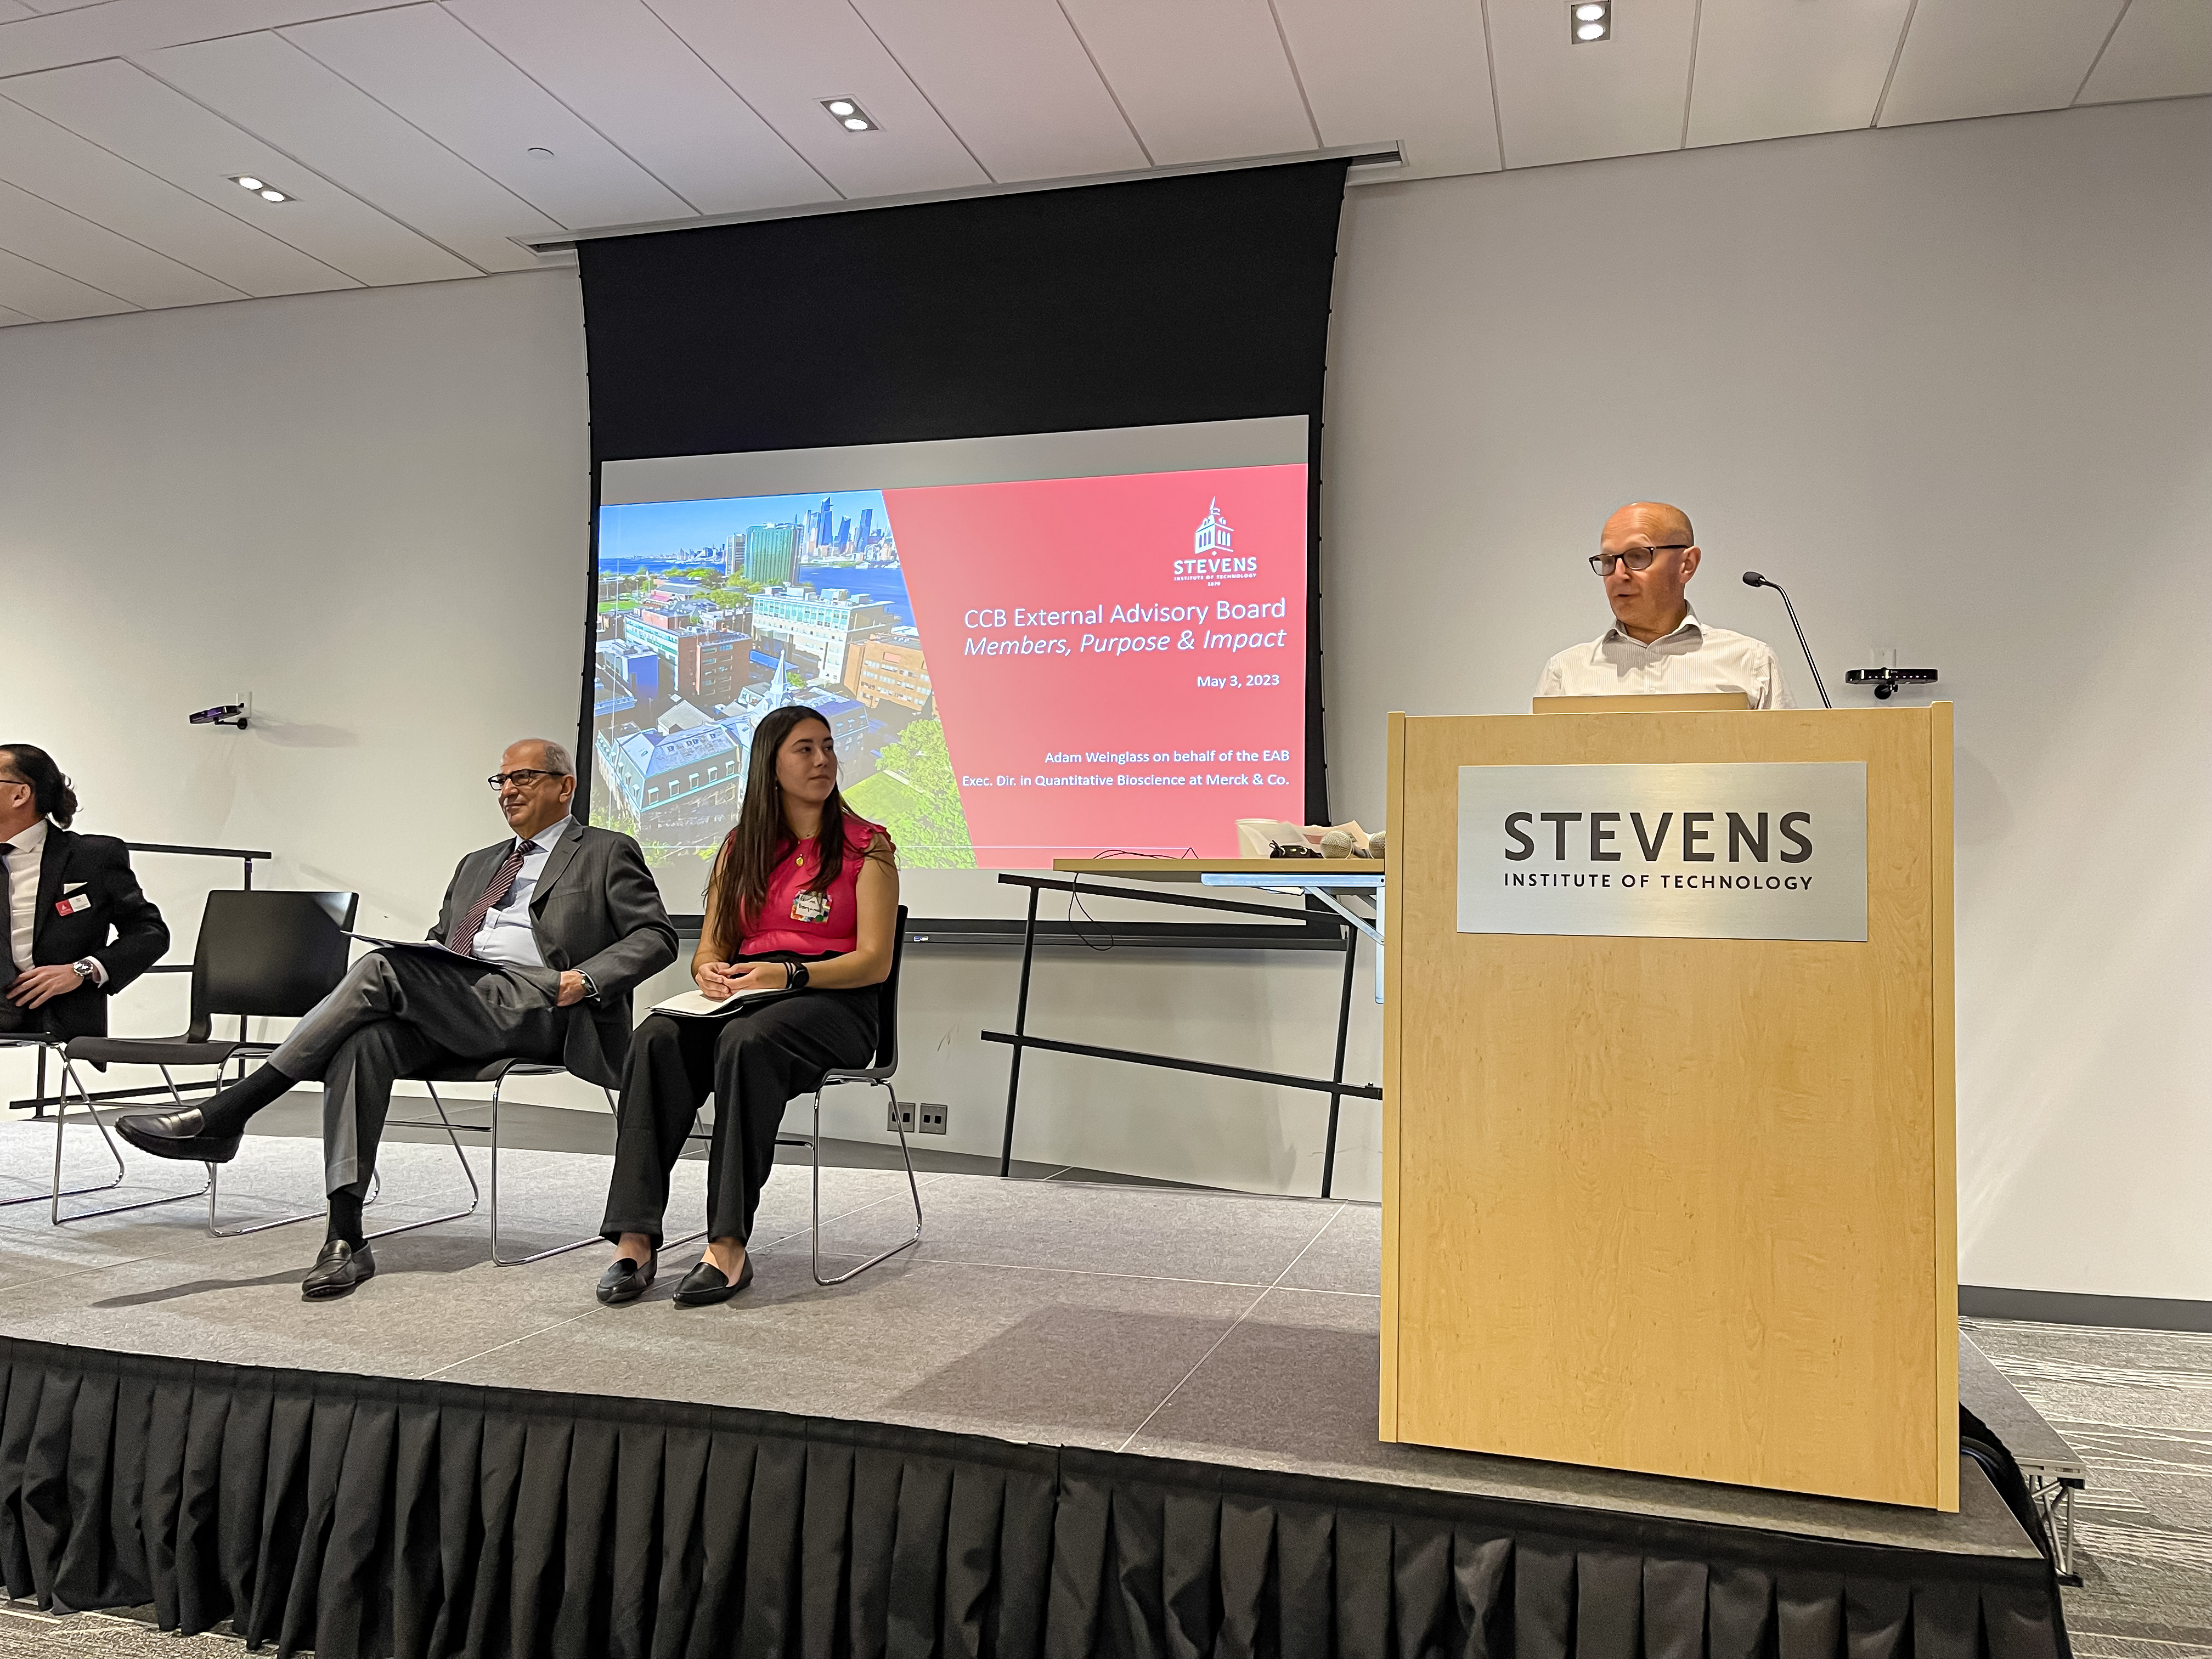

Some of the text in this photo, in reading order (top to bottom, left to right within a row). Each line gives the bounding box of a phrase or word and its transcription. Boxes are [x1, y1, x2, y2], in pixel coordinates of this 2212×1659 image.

[1174, 557, 1257, 574] STEVENS
[964, 597, 1285, 628] CCB External Advisory Board
[964, 629, 1287, 657] Members, Purpose & Impact
[1197, 674, 1280, 689] May 3, 2023
[1045, 750, 1290, 765] Adam Weinglass on behalf of the EAB
[962, 773, 1289, 787] Exec. Dir. in Quantitative Bioscience at Merck & Co.
[1504, 811, 1813, 864] STEVENS
[1504, 873, 1813, 891] INSTITUTE OF TECHNOLOGY
